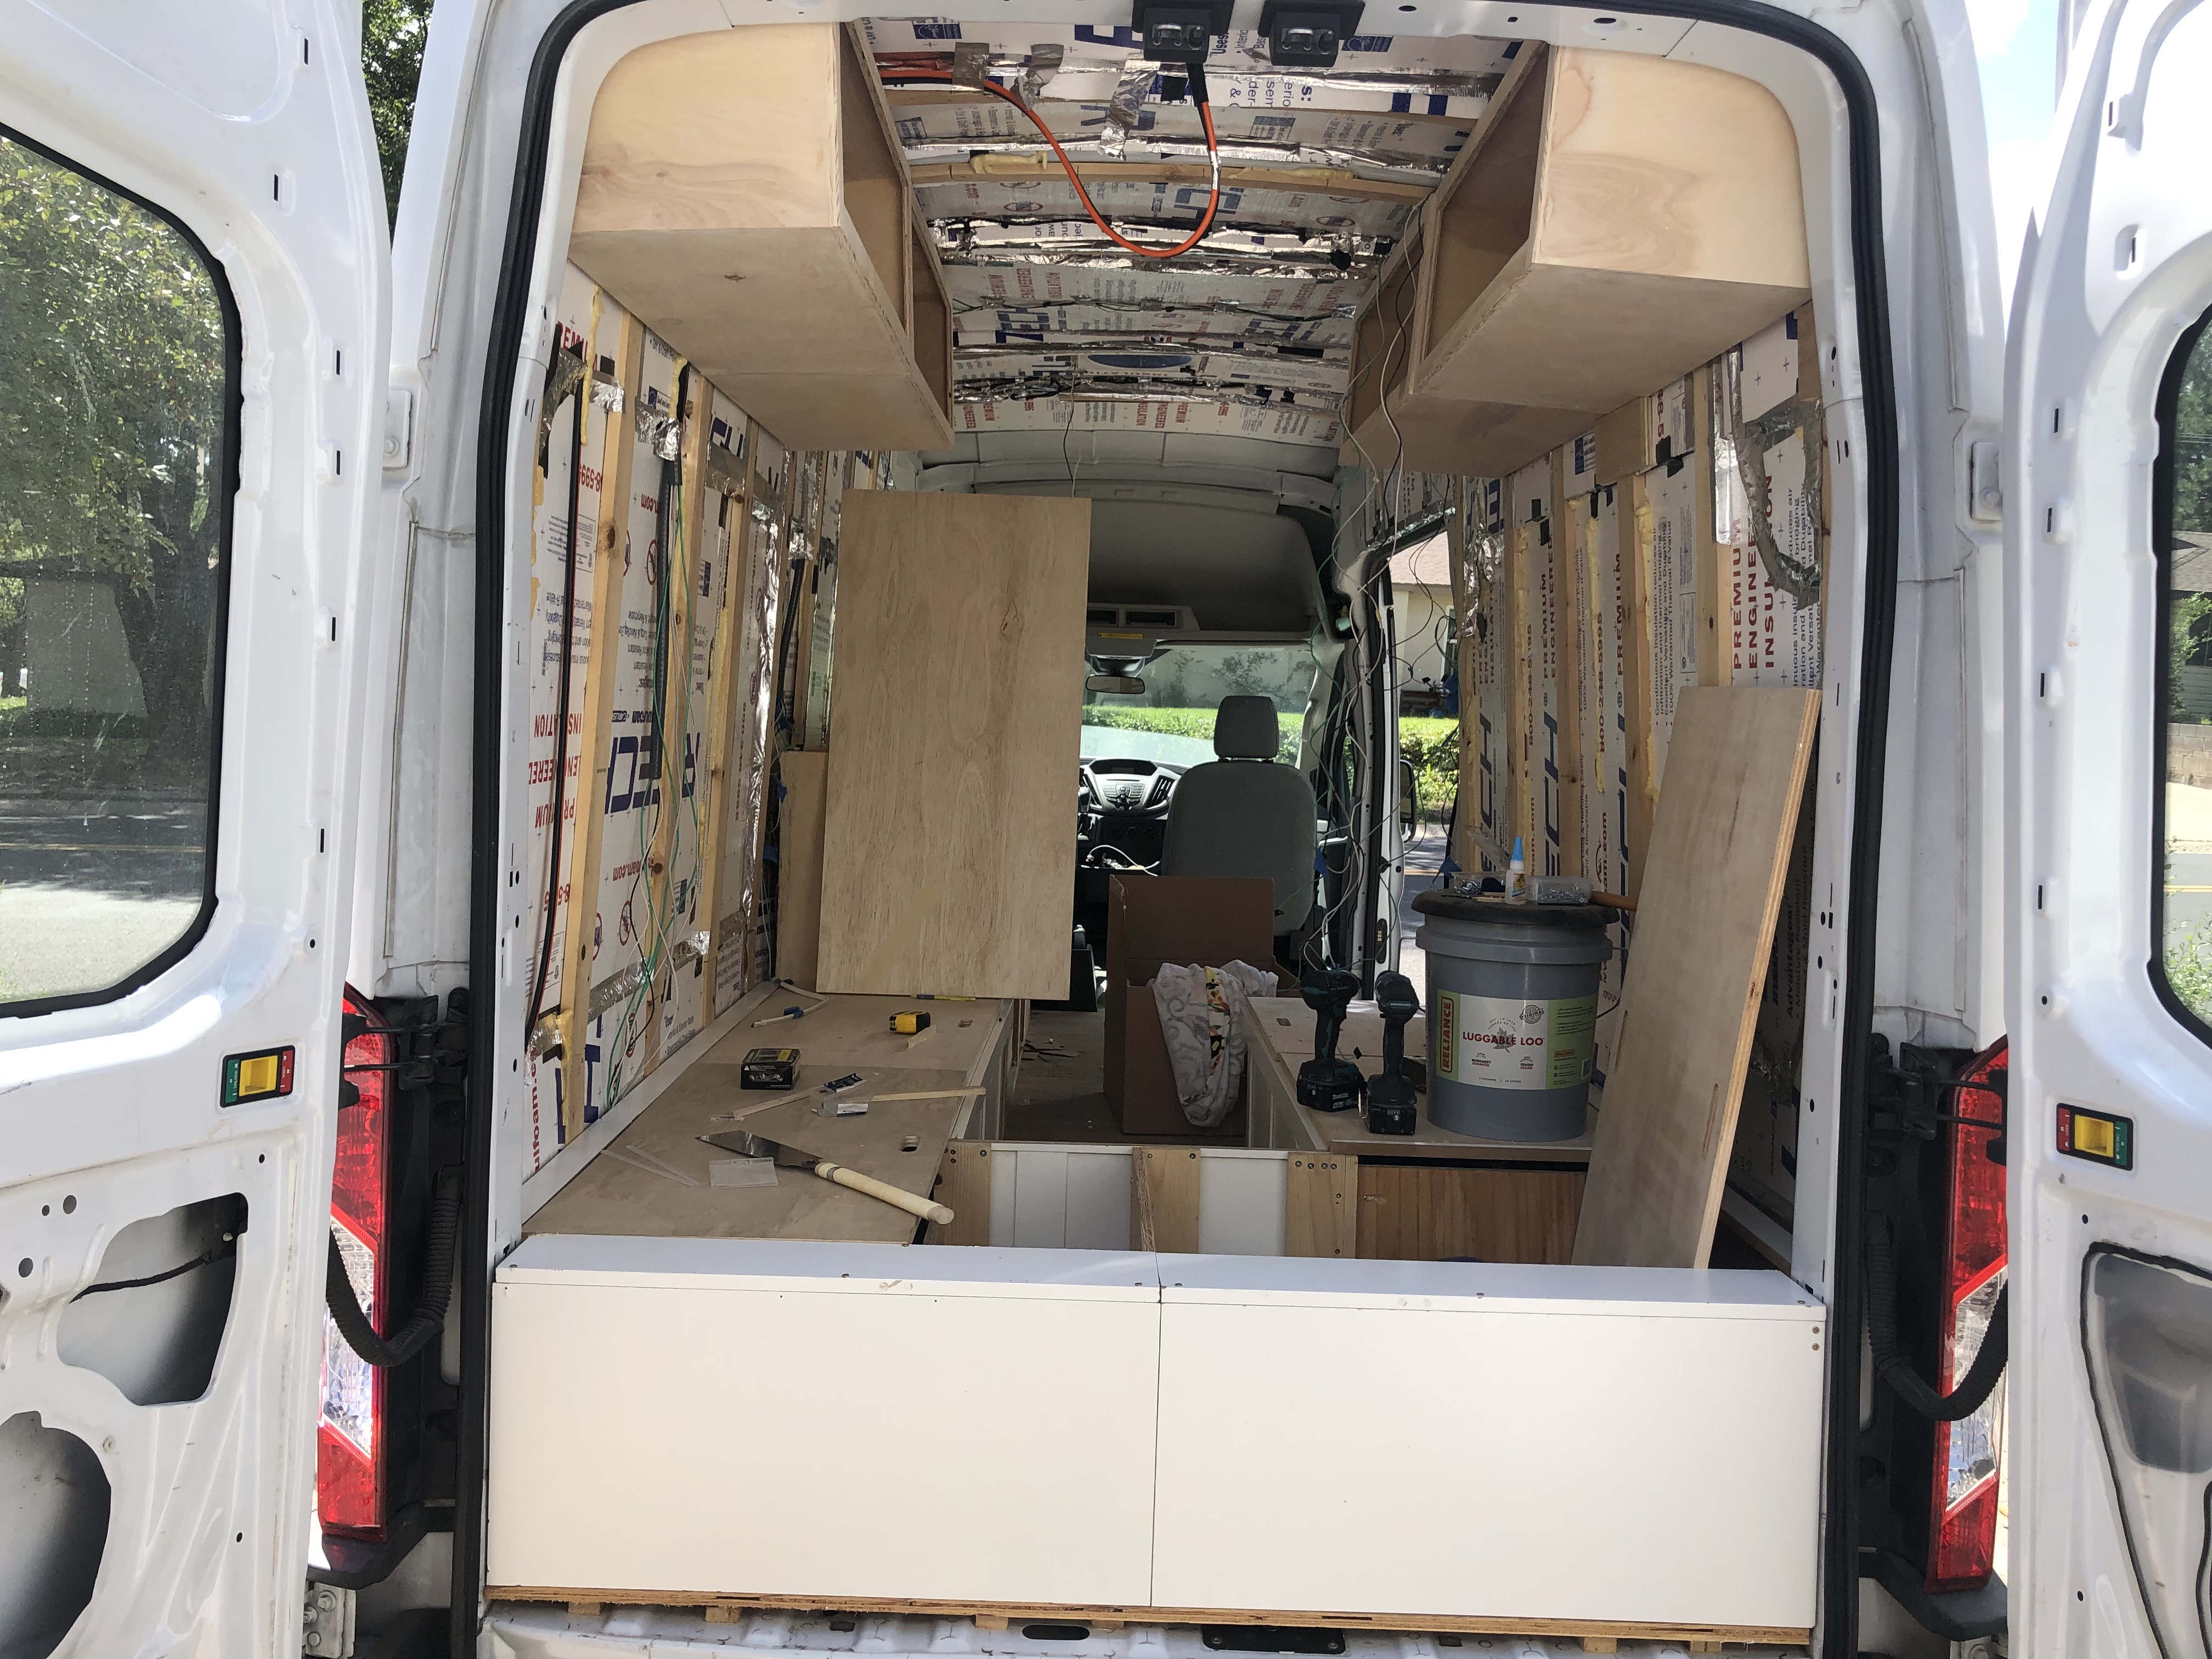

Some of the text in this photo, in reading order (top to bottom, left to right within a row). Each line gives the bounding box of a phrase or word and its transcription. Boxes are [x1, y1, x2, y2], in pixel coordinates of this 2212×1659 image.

[1733, 518, 1742, 670] PREMIUM
[534, 713, 582, 738] INSATION
[1442, 1001, 1451, 1068] RELIANCE
[1463, 1031, 1544, 1046] LUGGABLE LOO
